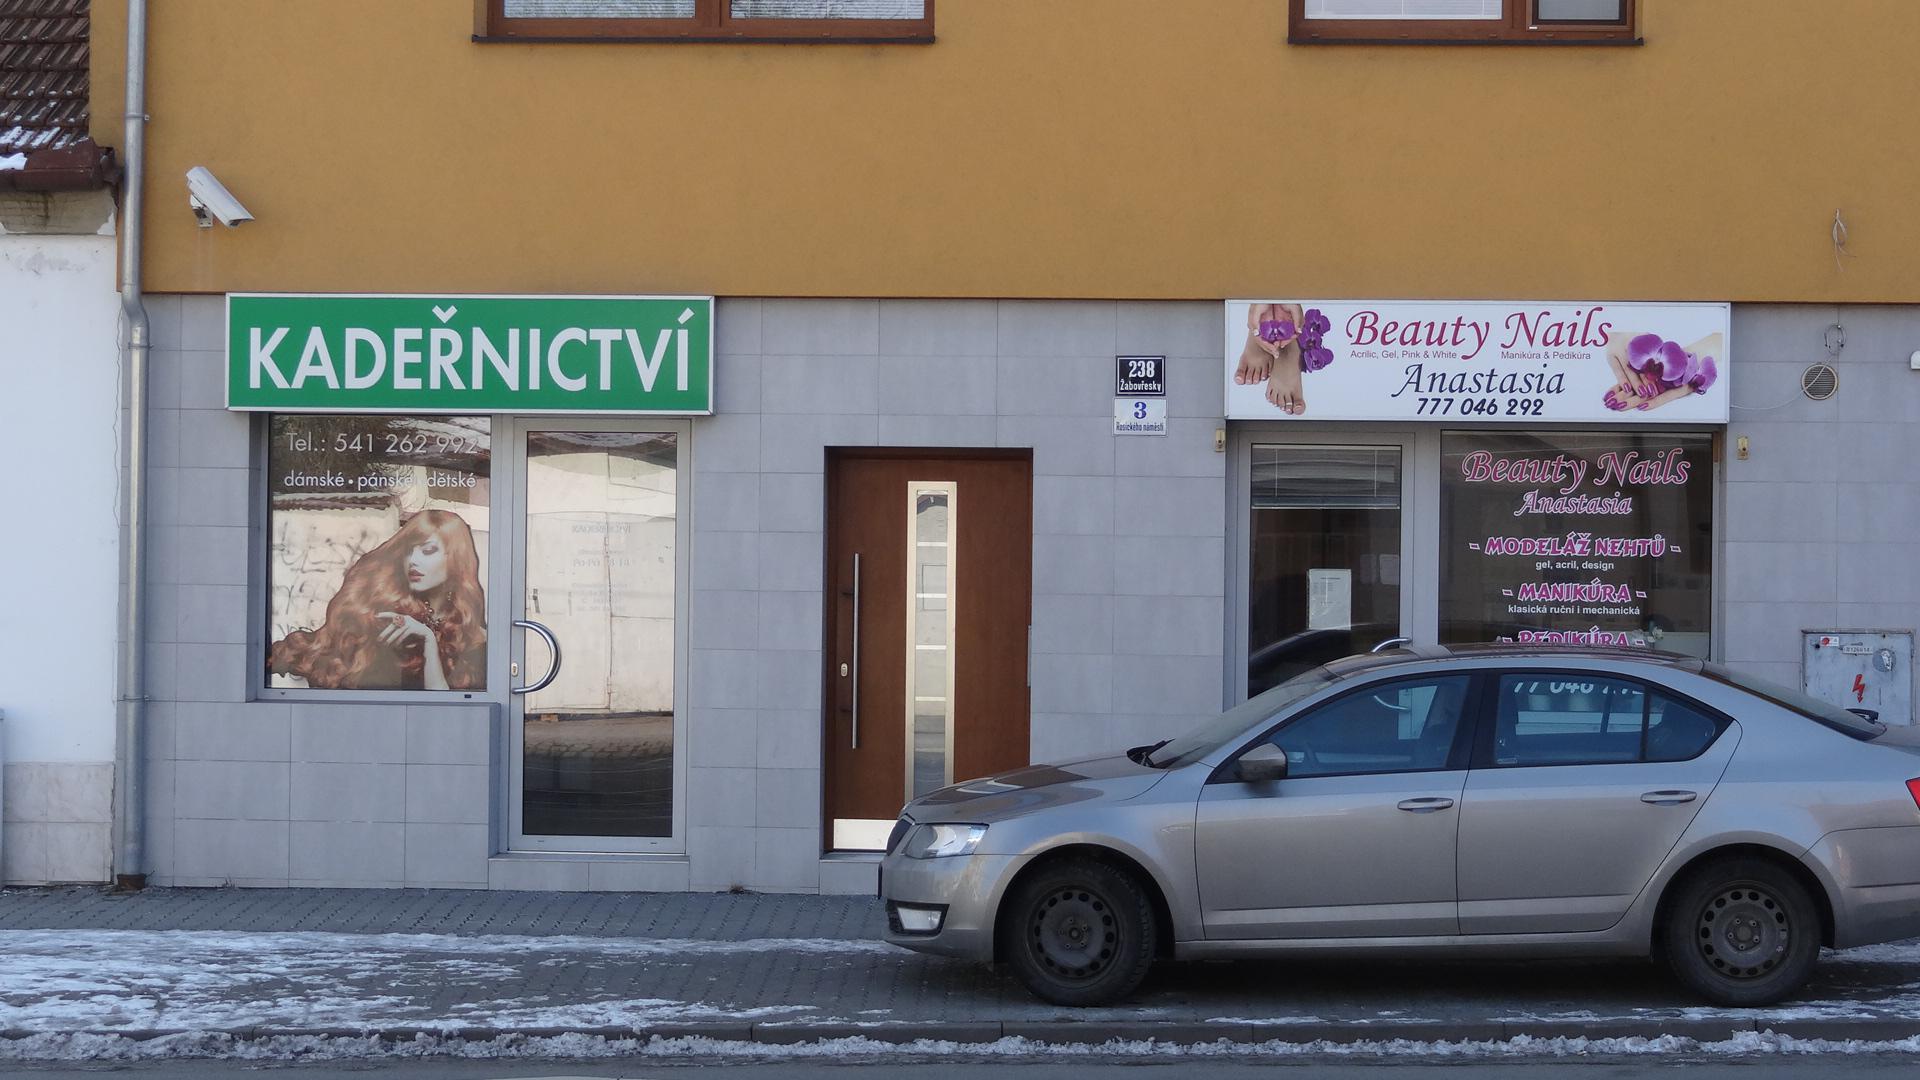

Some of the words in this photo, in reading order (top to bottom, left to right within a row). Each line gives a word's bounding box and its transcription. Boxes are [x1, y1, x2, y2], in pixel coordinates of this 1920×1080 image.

[1346, 311, 1490, 360] Beauty
[1500, 306, 1612, 350] Nails
[249, 305, 695, 392] KADEŘNICTVÍ
[1382, 350, 1398, 359] Gel,
[1129, 361, 1155, 378] 238
[1120, 379, 1161, 391] Žabovřesky
[1391, 363, 1565, 397] Anastasia
[1134, 402, 1147, 419] 3
[1417, 399, 1453, 415] 777
[1461, 399, 1498, 415] 046
[1506, 399, 1543, 416] 292
[287, 432, 325, 452] Tel.:
[334, 433, 374, 452] 541
[385, 434, 427, 453] 262
[437, 435, 478, 454] 992
[284, 470, 344, 486] dámské
[427, 472, 476, 488] dětské
[1462, 450, 1587, 494] Beauty
[1594, 448, 1691, 487] Nails
[1514, 490, 1632, 516] Anastasia
[1485, 532, 1591, 557] MODELÁŽ
[1595, 534, 1665, 557] NEHTŮ
[1536, 561, 1553, 570] gel,
[1556, 561, 1579, 570] acril,
[1582, 561, 1614, 571] design
[1518, 578, 1631, 603] MANIKÚRA
[1508, 605, 1547, 613] klasická
[1550, 605, 1574, 613] ruční
[1583, 606, 1640, 615] mechanická
